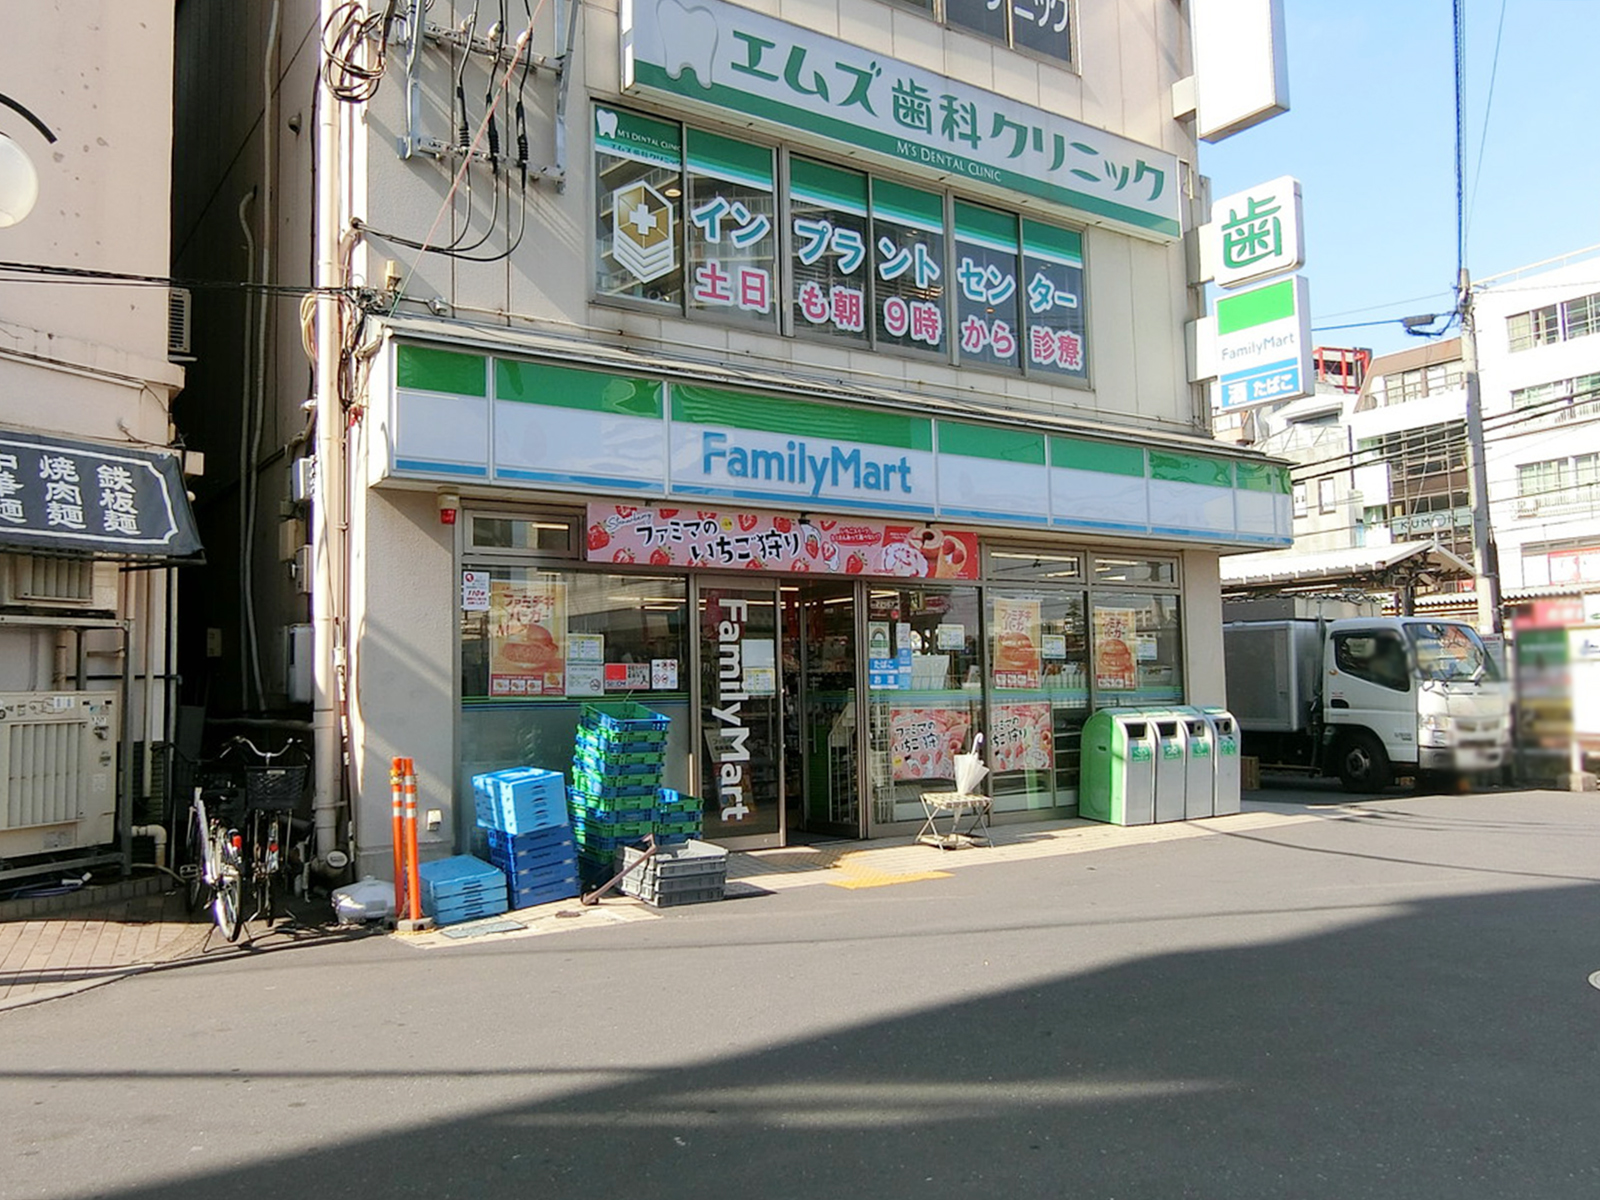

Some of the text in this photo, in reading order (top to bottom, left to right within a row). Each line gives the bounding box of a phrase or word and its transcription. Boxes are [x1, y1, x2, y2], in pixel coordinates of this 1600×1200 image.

[631, 133, 660, 147] DENTAL
[732, 30, 1165, 201] エムズ歯科クリニック
[921, 147, 965, 172] DENTAL
[968, 162, 1002, 182] CLINIC
[1220, 196, 1282, 269] 歯
[1221, 333, 1294, 361] FamilyMart
[1252, 374, 1294, 398] たばこ
[702, 430, 912, 497] FamilyMart
[39, 454, 87, 530] 焼肉麺
[96, 464, 142, 535] 鉄板麺
[636, 520, 718, 546] ファミマの
[691, 529, 800, 564] いちご狩り
[711, 598, 751, 822] FamilyMart
